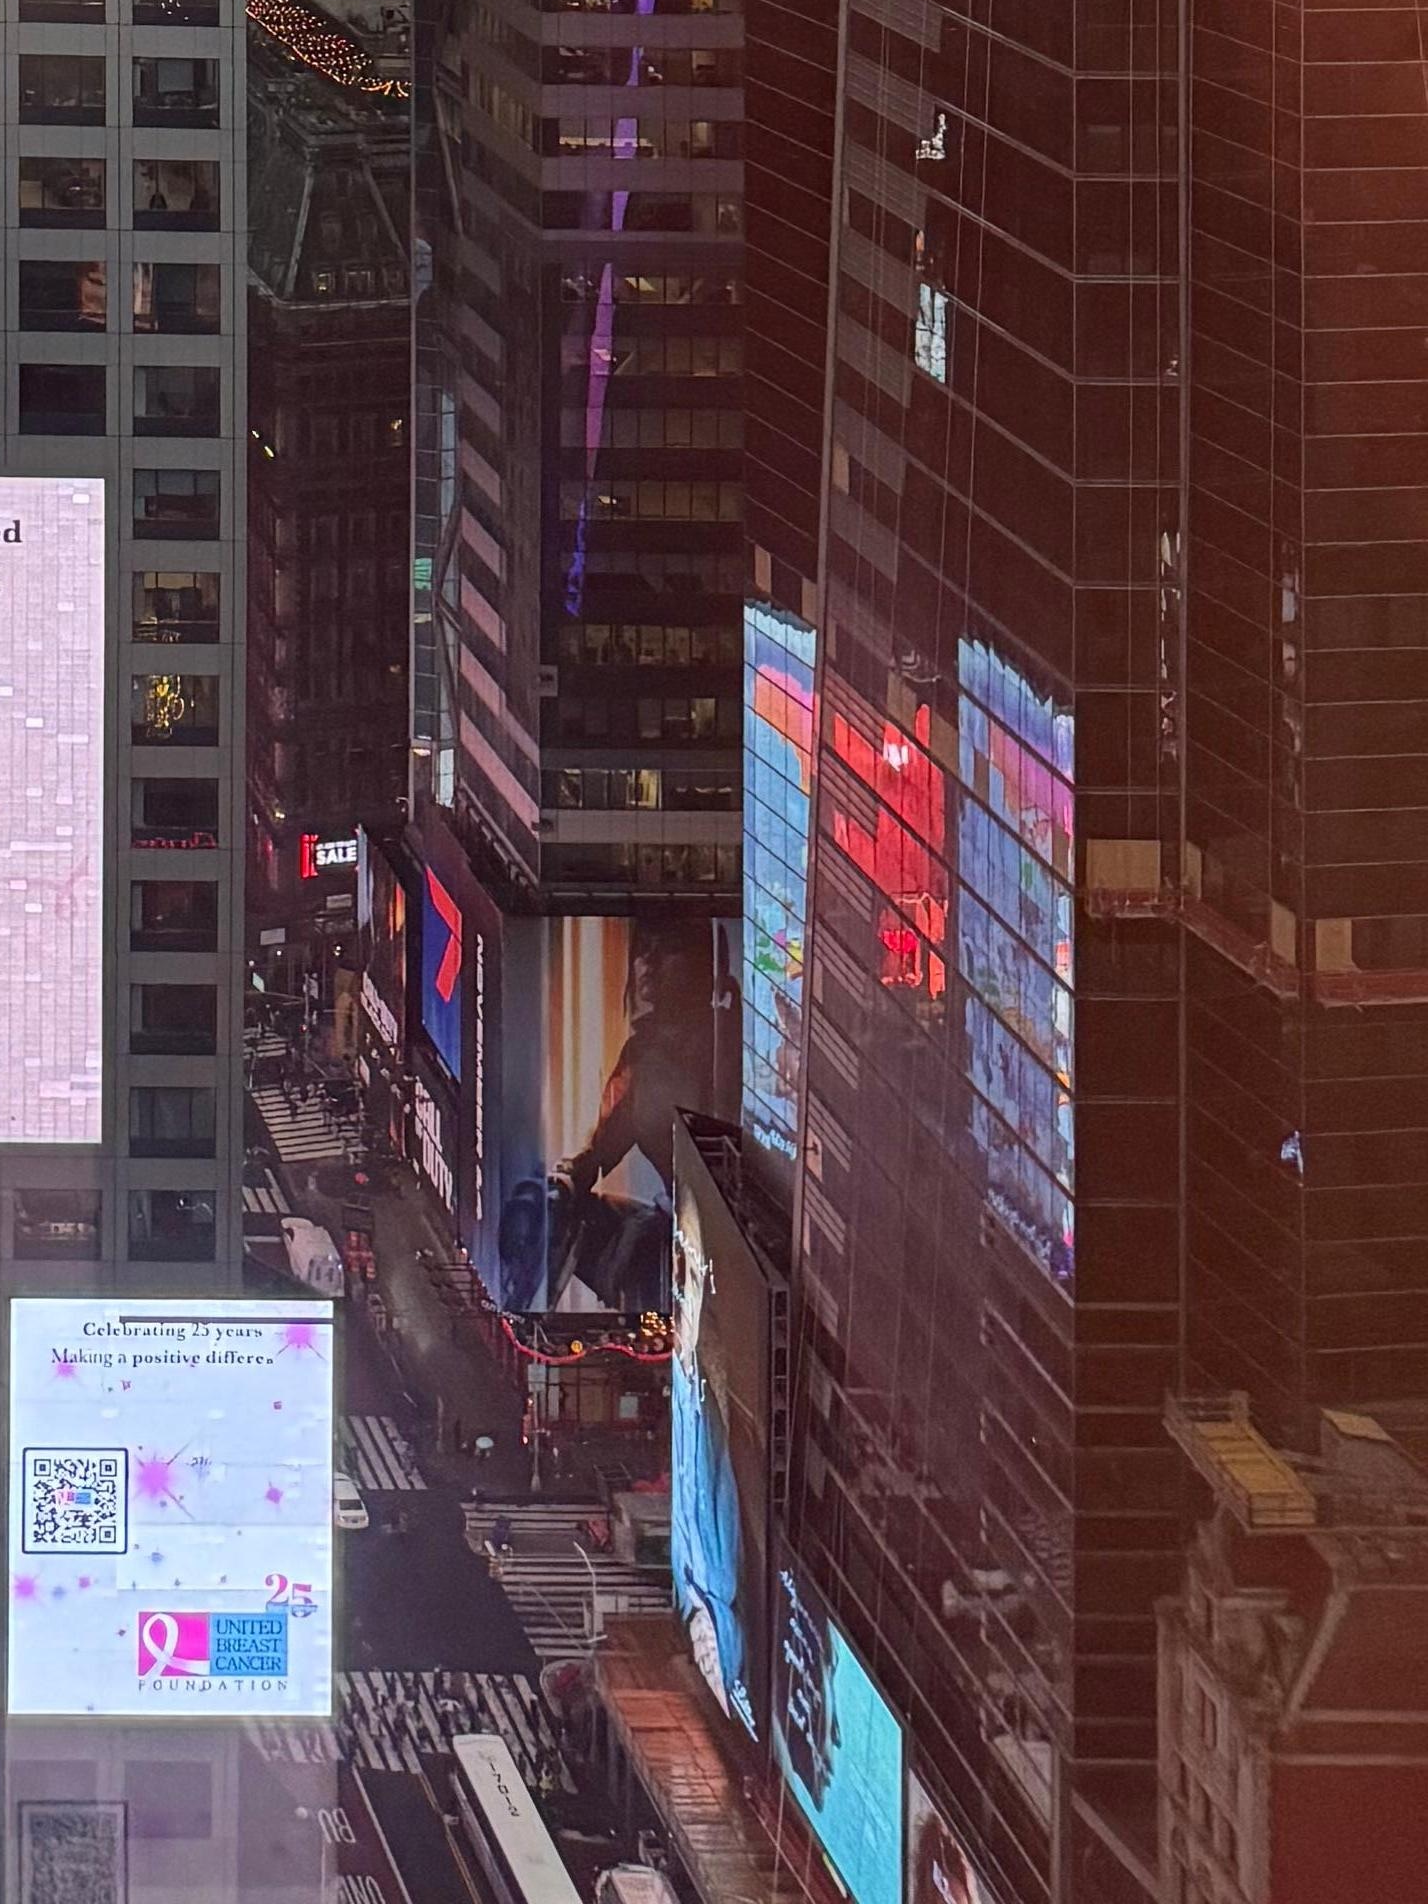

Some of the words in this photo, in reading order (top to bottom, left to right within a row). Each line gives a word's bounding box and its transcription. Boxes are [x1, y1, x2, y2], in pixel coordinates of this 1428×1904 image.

[316, 847, 357, 865] SALE
[423, 1129, 454, 1210] DUTY
[83, 1321, 186, 1341] Celebrating
[191, 1321, 210, 1337] 25
[215, 1326, 263, 1342] years
[51, 1348, 113, 1368] Making
[117, 1353, 127, 1364] a
[132, 1349, 201, 1368] positive
[216, 1619, 283, 1636] UNITED
[216, 1638, 281, 1654] BREAST
[215, 1655, 282, 1672] CANCER
[138, 1679, 288, 1692] FOUNDATION
